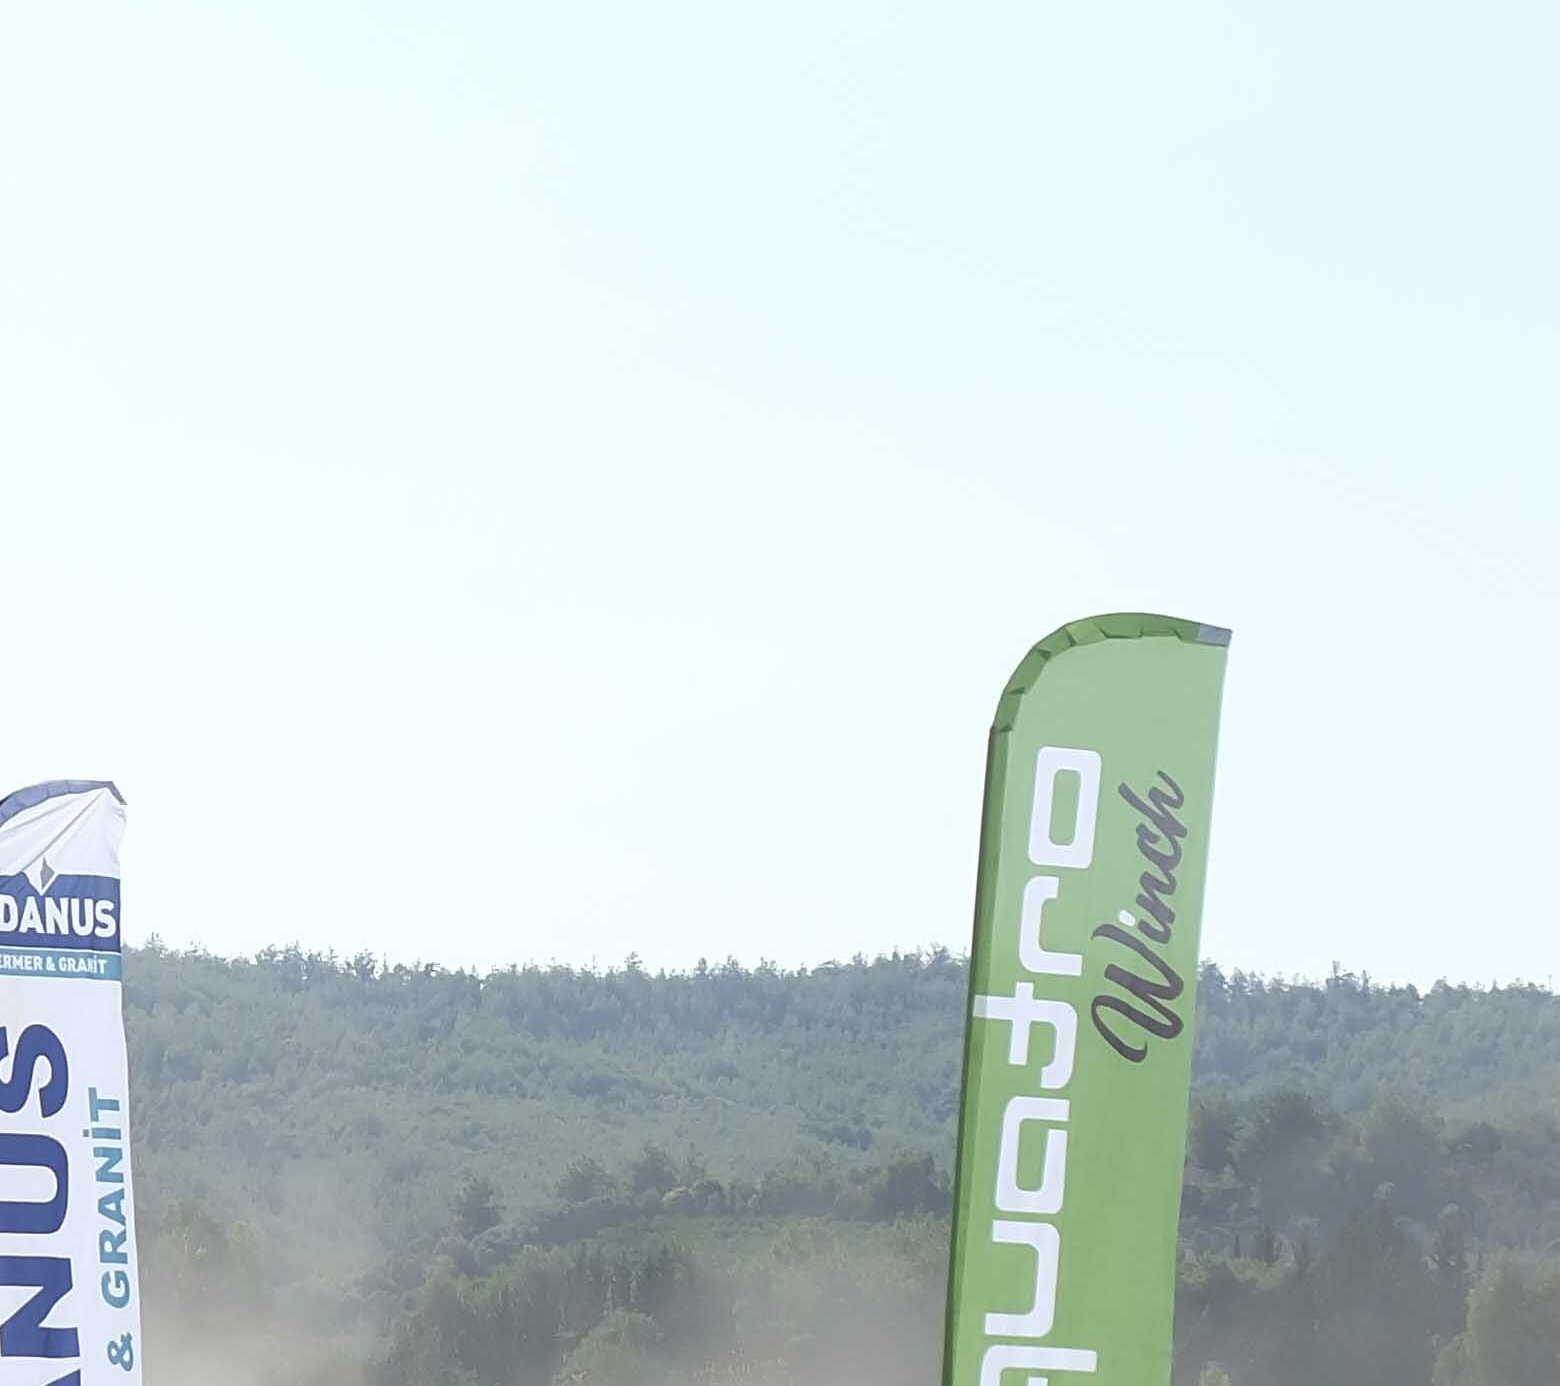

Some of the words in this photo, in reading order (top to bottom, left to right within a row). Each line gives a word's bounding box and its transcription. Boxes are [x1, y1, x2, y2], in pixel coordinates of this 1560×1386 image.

[45, 957, 56, 971] &
[1091, 769, 1189, 1065] Winch
[82, 1087, 132, 1309] GRANİT
[106, 1332, 135, 1373] &
